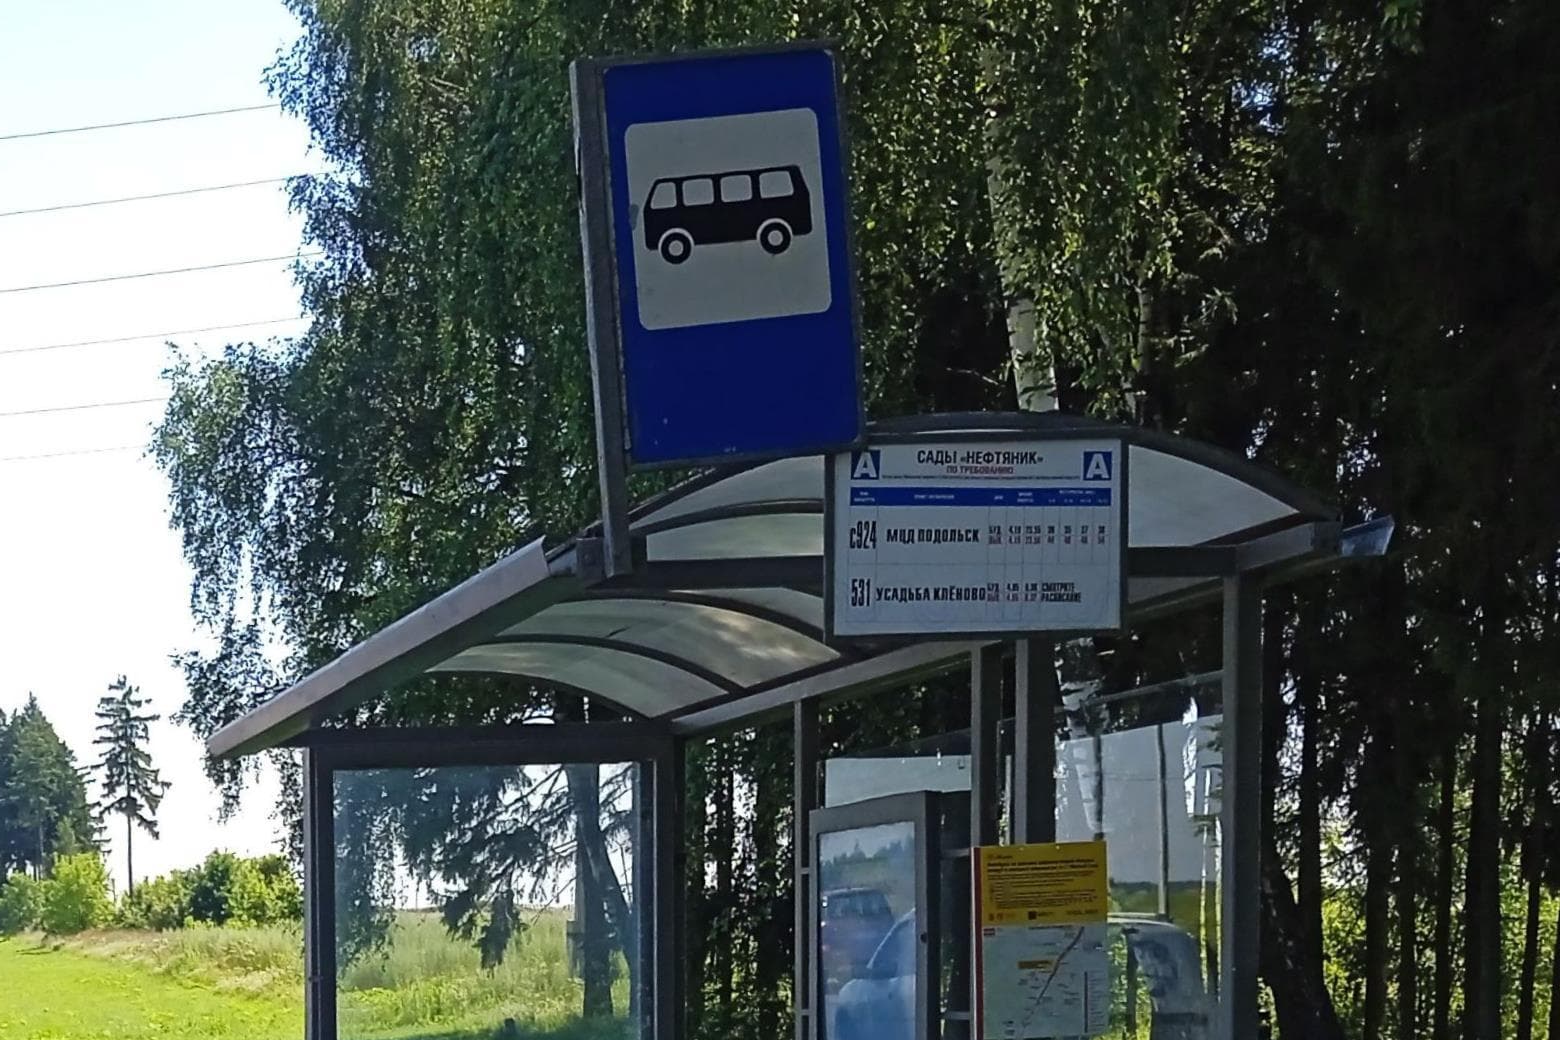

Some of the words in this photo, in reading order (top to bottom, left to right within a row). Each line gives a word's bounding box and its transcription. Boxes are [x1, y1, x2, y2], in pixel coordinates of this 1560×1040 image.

[917, 450, 957, 465] САДЫ
[960, 451, 1043, 465] «НЕФТЯНИК»
[946, 465, 958, 474] ПО
[960, 465, 1014, 475] ТРЕБОВАНИЮ
[886, 529, 915, 544] МЦД
[918, 529, 980, 544] ПОДОЛЬСК
[851, 579, 871, 607] 531
[876, 587, 931, 602] УСАДЬБА
[933, 585, 986, 601] КЛЁНОВО
